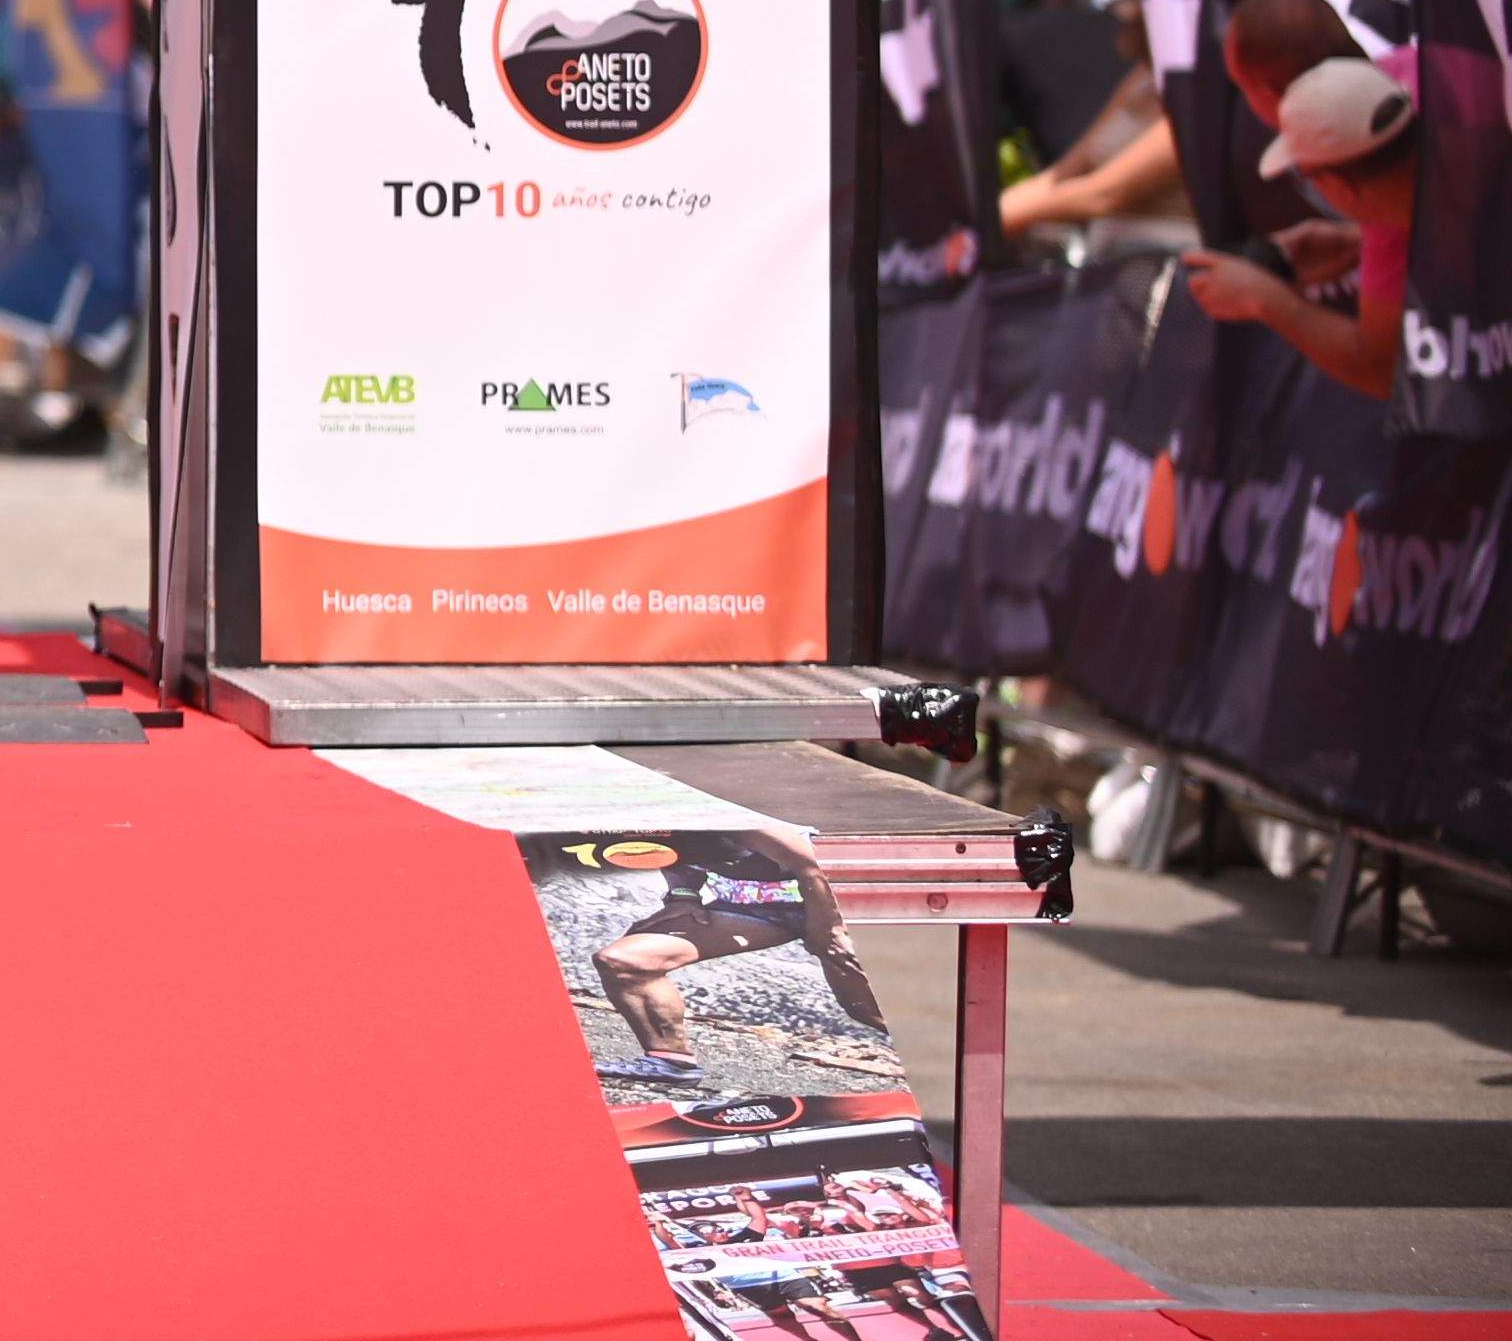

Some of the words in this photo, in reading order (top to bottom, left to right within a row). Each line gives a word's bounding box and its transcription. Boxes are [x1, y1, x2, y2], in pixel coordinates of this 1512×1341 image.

[577, 52, 651, 82] ANETO
[561, 82, 651, 112] POSETS
[552, 187, 612, 210] años
[622, 188, 712, 216] contigo
[481, 377, 611, 412] PRAMES
[321, 589, 412, 614] Huesca
[432, 589, 528, 614] Pirineos
[547, 589, 606, 613] Valle
[612, 589, 642, 613] de
[648, 589, 766, 620] Benasque
[722, 1242, 784, 1259] GRAN
[791, 1236, 850, 1253] TRAIL
